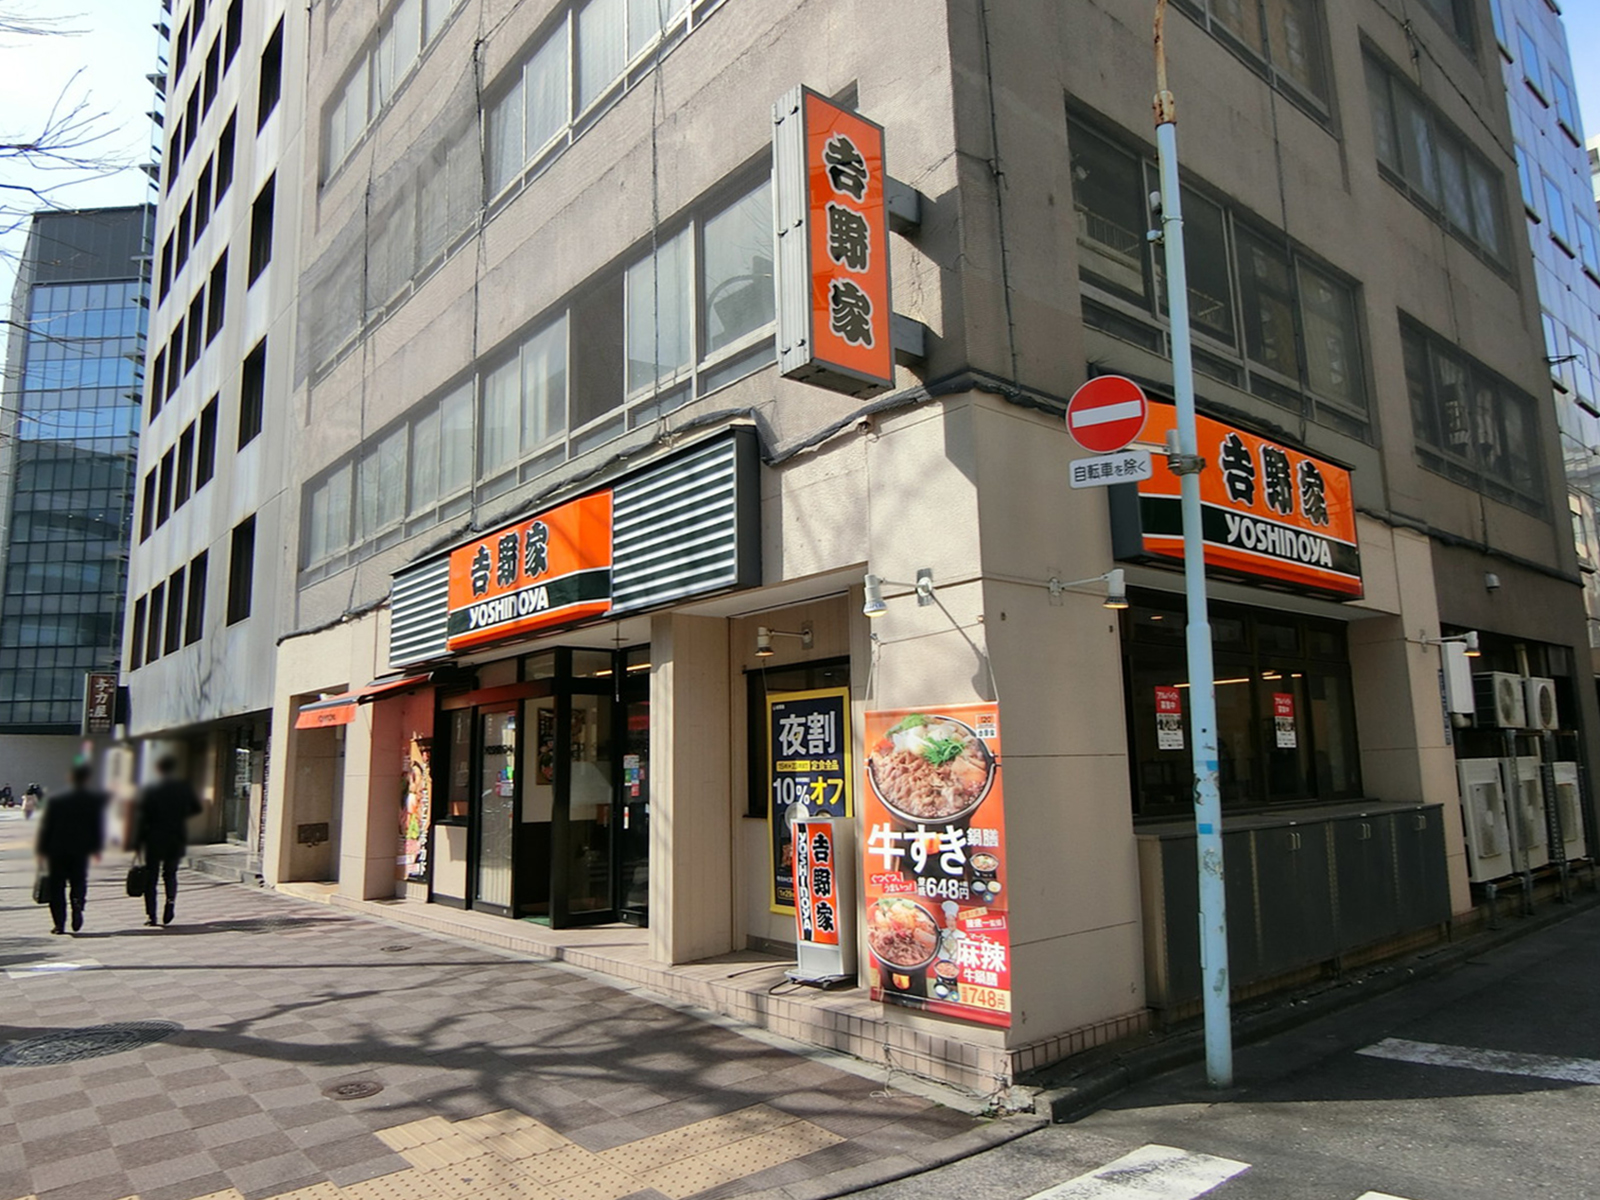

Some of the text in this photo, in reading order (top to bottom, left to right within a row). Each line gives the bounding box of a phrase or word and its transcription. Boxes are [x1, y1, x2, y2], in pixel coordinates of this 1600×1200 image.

[822, 131, 875, 349] 吉野家
[1074, 458, 1148, 483] 自転車を除く
[1218, 432, 1330, 527] 吉野家
[470, 520, 549, 599] 吉野家
[1225, 513, 1333, 567] YOSHINOYA
[469, 585, 549, 629] YOSHINOYA
[779, 710, 836, 756] 夜割
[867, 822, 967, 875] 牛すき
[798, 832, 812, 931] YOSHINOYA
[812, 832, 836, 933] 吉野家
[956, 938, 1007, 972] 麻辣
